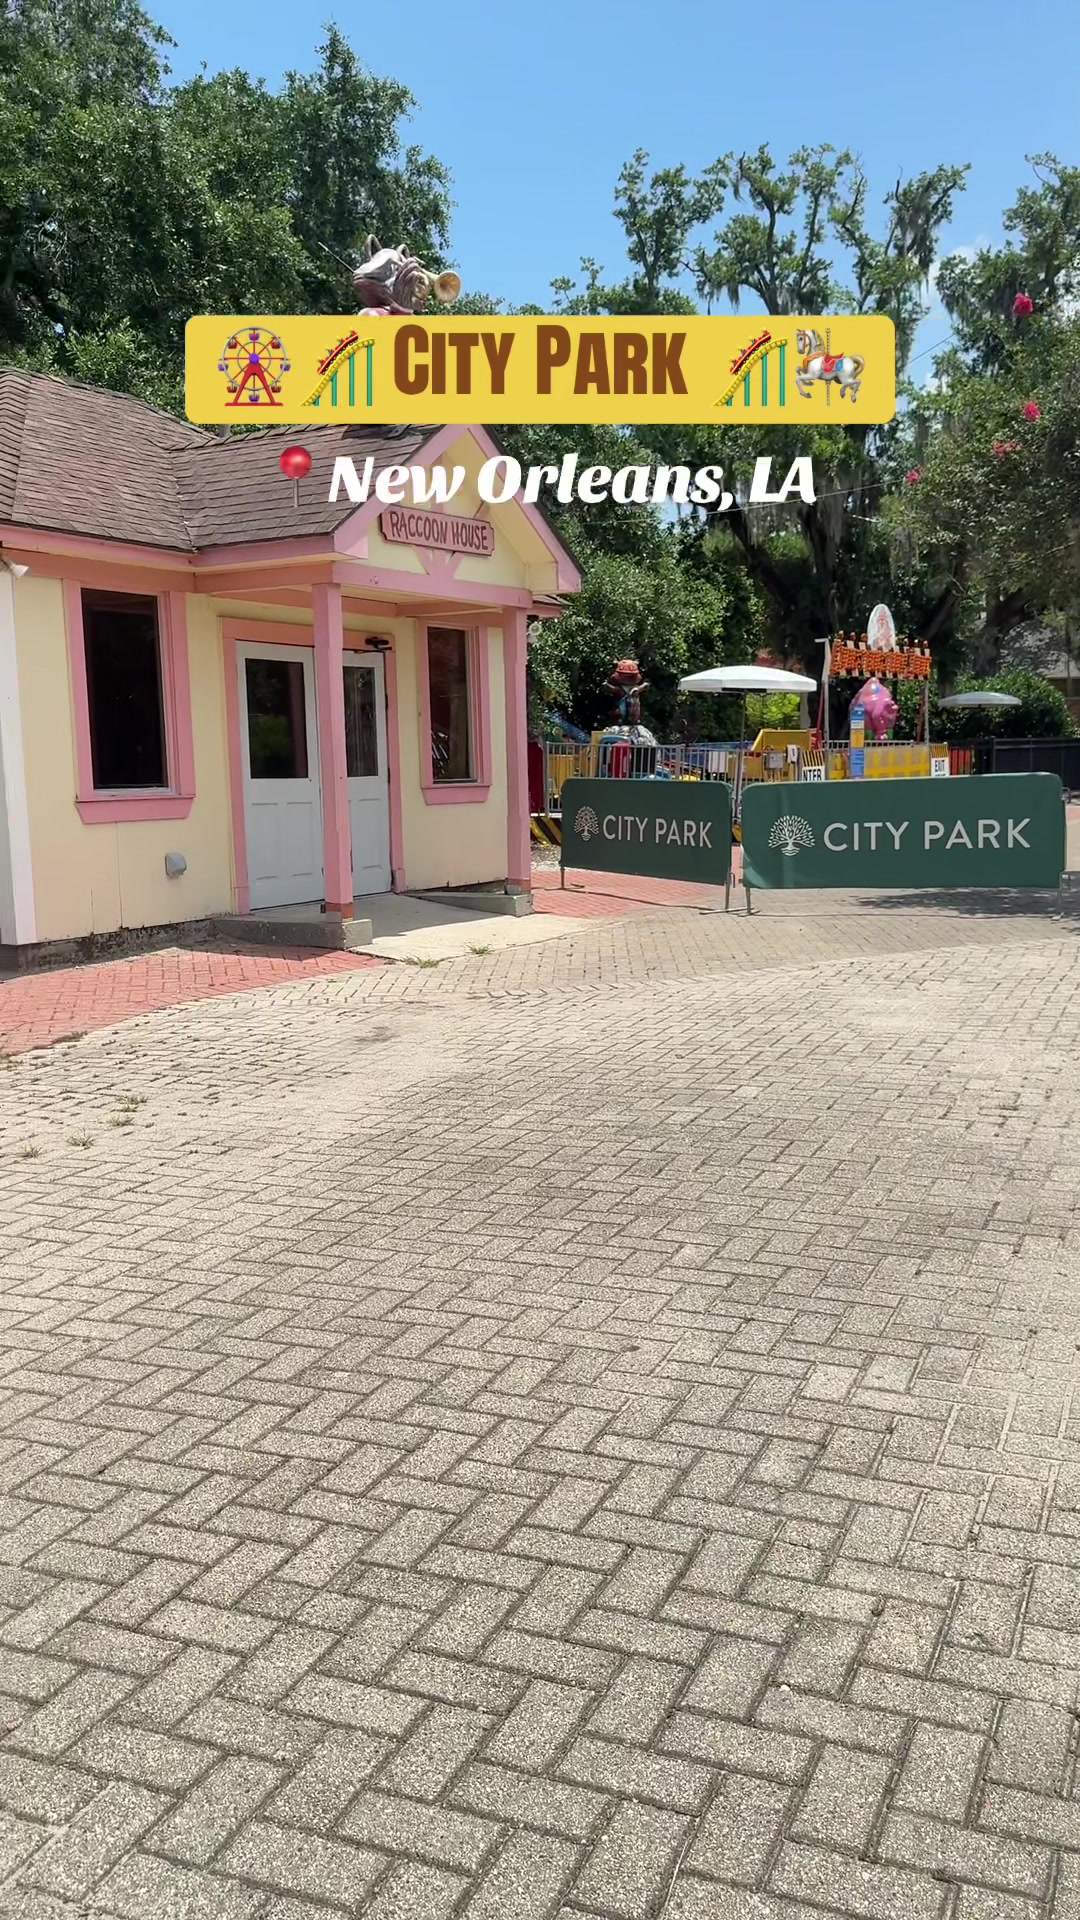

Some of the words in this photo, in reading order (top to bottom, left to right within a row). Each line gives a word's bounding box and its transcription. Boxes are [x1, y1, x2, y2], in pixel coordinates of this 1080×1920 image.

[390, 511, 447, 544] RACCOON
[451, 522, 488, 550] HOUSE
[802, 769, 822, 782] NTER
[603, 815, 648, 842] CITY
[655, 818, 712, 848] PARK
[823, 821, 909, 851] CITY
[924, 818, 1031, 849] PARK
